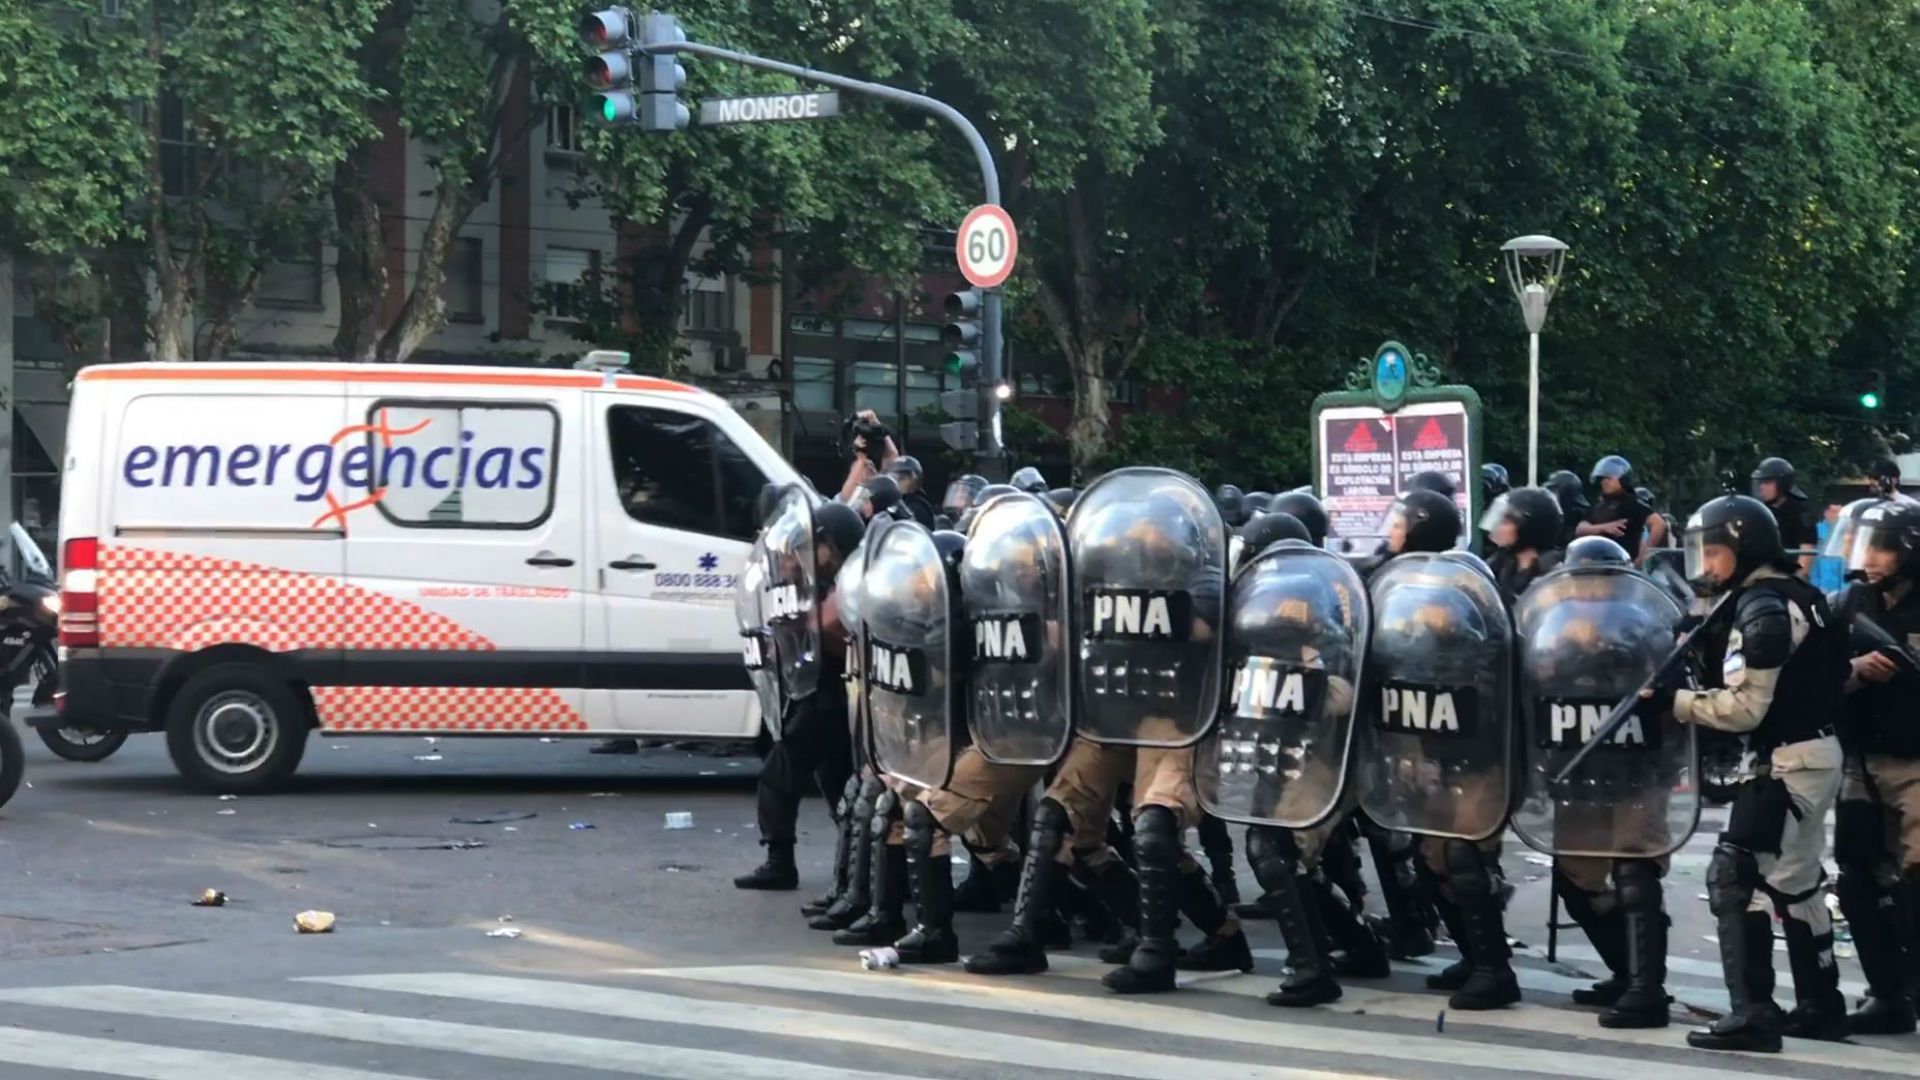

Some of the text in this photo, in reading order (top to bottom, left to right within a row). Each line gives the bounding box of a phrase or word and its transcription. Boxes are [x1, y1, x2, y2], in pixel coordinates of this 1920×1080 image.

[719, 94, 819, 121] MONROE
[968, 228, 1006, 264] 60
[123, 429, 545, 502] emergencias
[655, 573, 691, 587] 0800
[1093, 595, 1172, 635] PNA
[975, 619, 1027, 659] PNA
[1231, 667, 1305, 711] PNA
[1382, 686, 1459, 731] PNA
